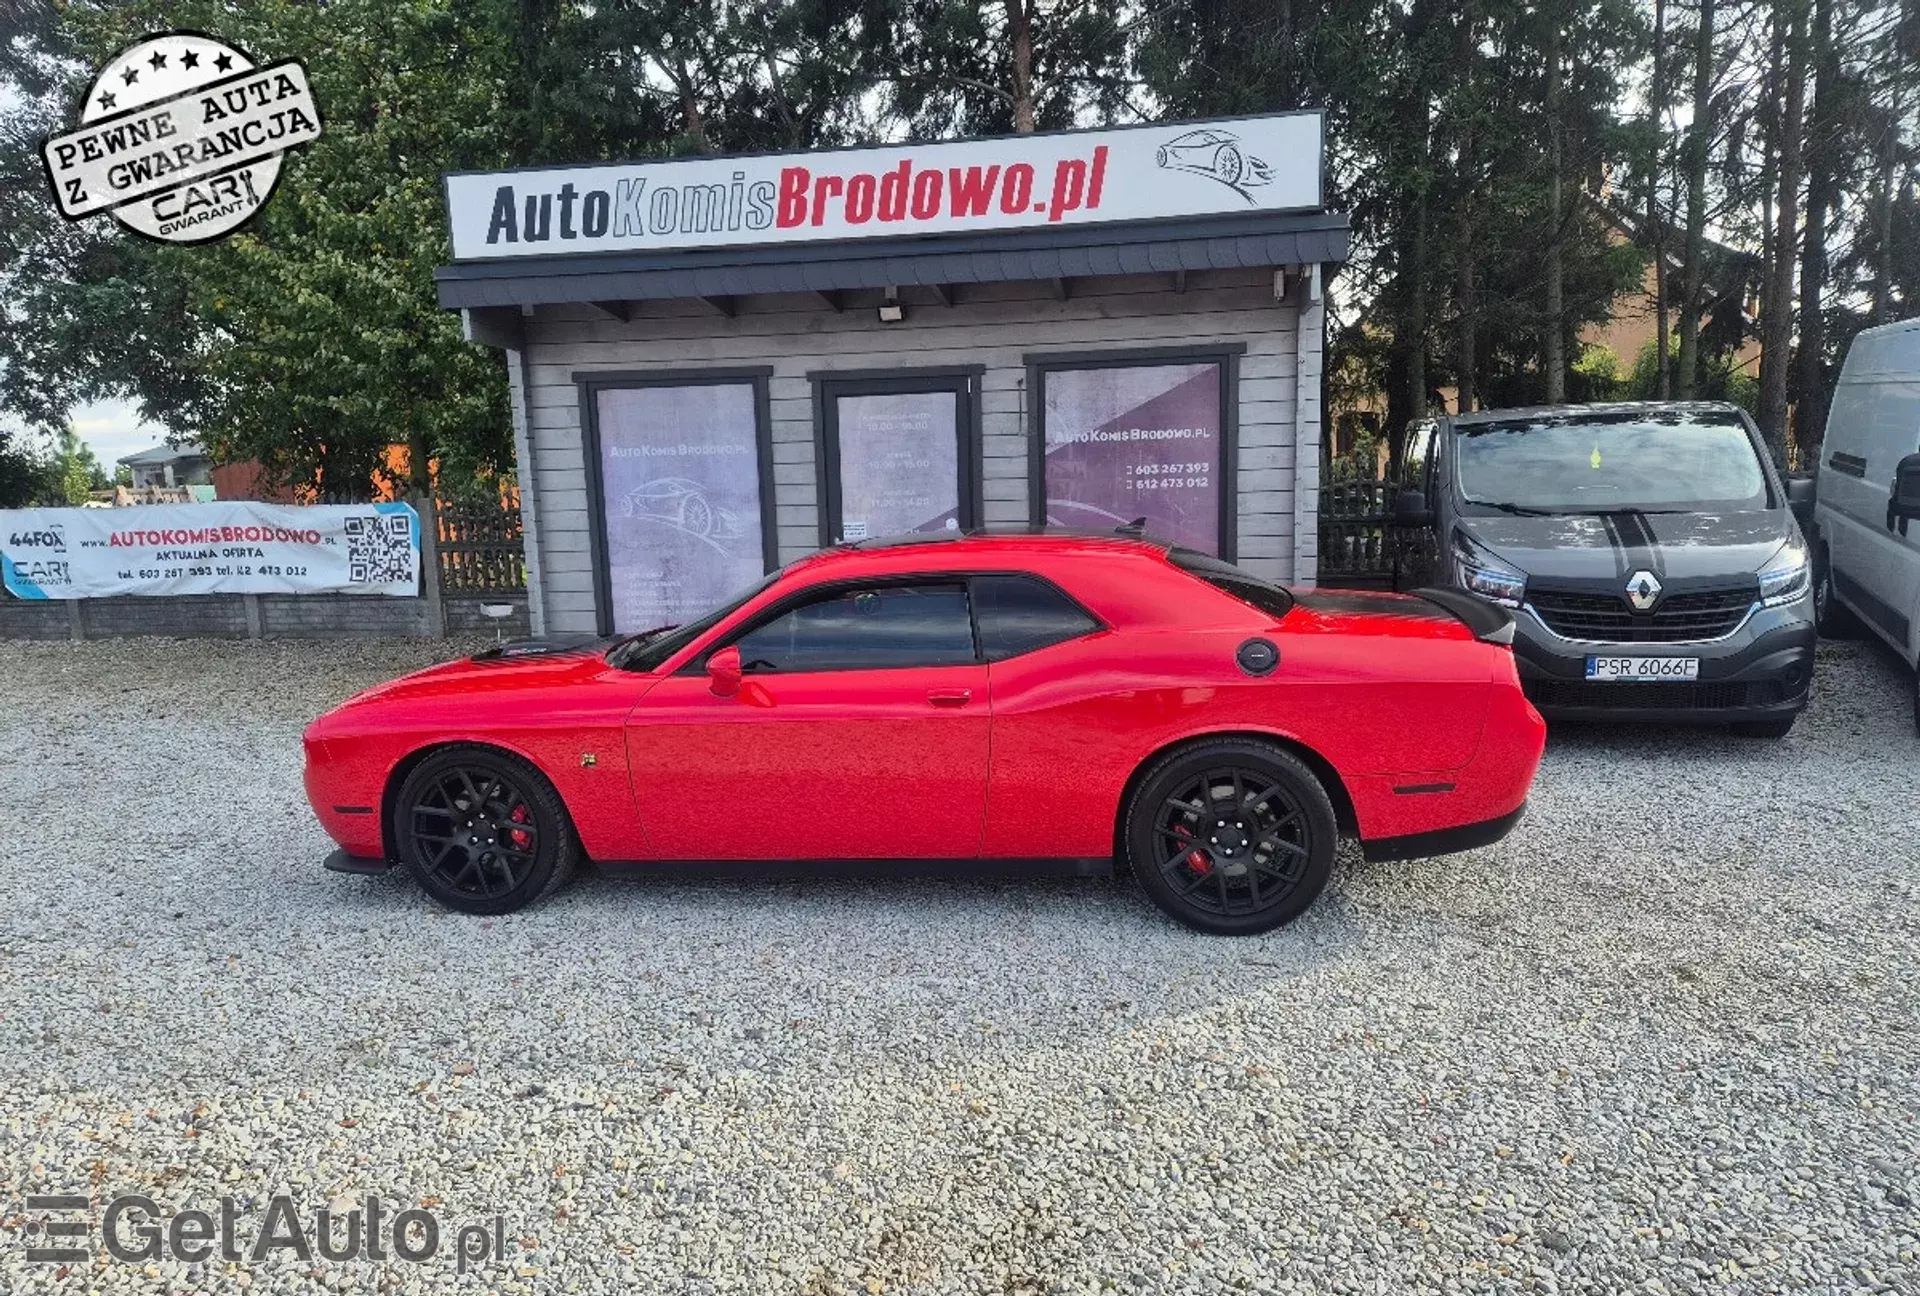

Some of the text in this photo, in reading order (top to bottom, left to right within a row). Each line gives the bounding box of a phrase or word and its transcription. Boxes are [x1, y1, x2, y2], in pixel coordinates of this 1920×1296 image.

[485, 145, 1109, 245] AutoKomisBrodowo.pl
[1135, 462, 1209, 475] 603 267 393
[1160, 478, 1184, 488] 473
[1186, 477, 1209, 488] 012
[156, 549, 218, 561] AKTUALNA
[139, 569, 160, 579] 603
[216, 565, 233, 576] tel.
[286, 566, 308, 576] 012
[1596, 659, 1632, 675] PSR
